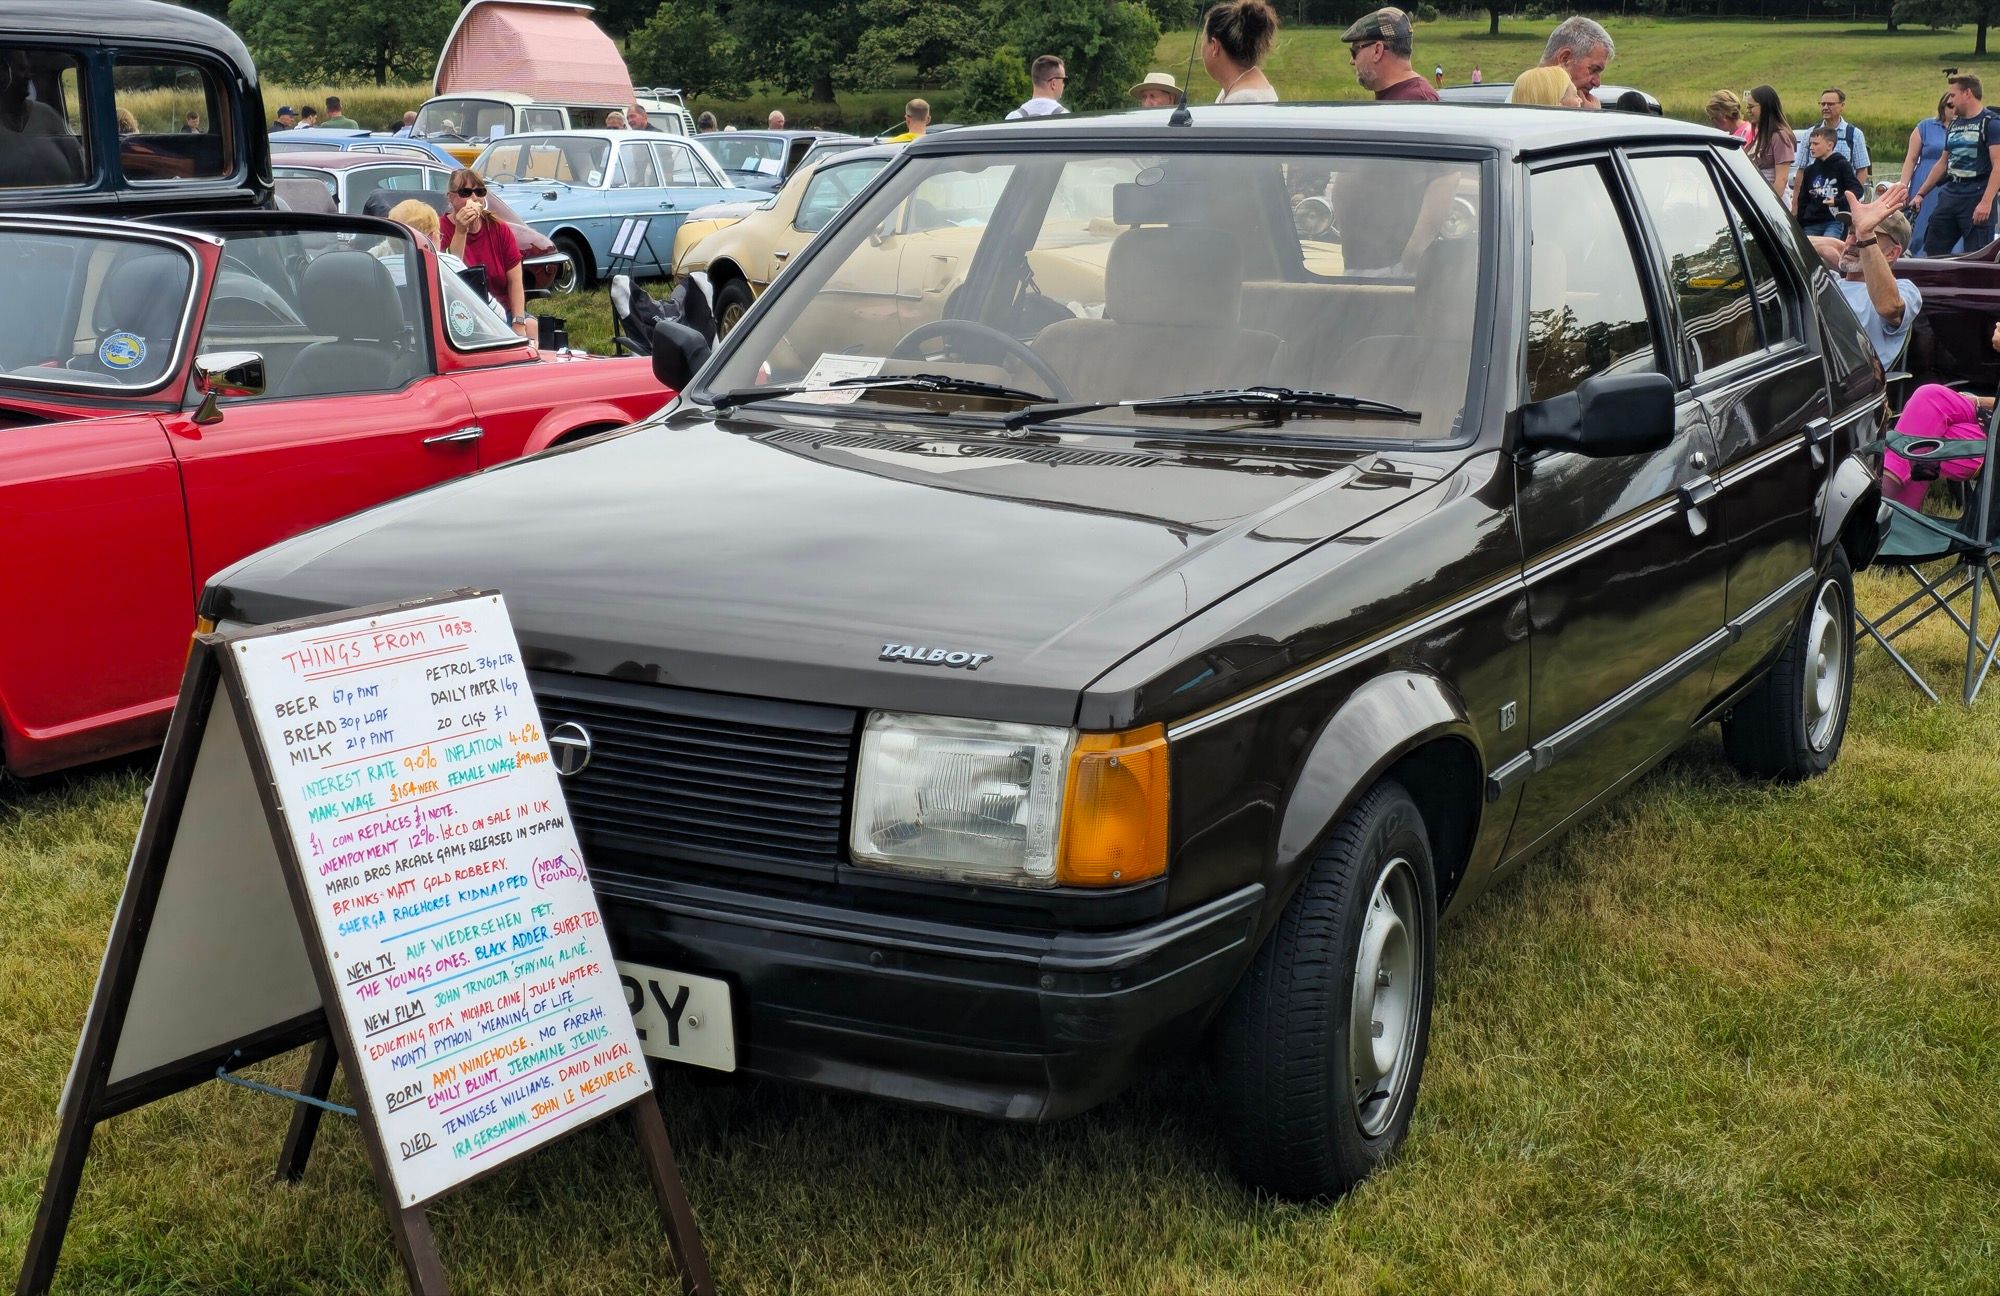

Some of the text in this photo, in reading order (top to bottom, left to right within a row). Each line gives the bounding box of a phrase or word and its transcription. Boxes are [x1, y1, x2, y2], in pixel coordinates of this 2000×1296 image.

[282, 621, 477, 673] THINGS FROM 1983.
[426, 661, 476, 681] PETROL
[499, 653, 515, 665] LTR
[879, 643, 993, 671] TALBOT
[275, 696, 319, 718] BEER
[357, 685, 379, 698] PINT
[431, 685, 466, 705] DAILY
[470, 679, 499, 697] PAPER
[283, 720, 337, 746] BREAD
[364, 708, 388, 725] LOAF
[437, 705, 508, 731] 20 CIGS £1
[289, 741, 332, 766] MILK
[370, 730, 394, 745] PINT
[302, 768, 361, 801] INTEREST
[367, 760, 399, 783] RATE
[445, 734, 503, 763] INFLATION
[308, 803, 340, 824] MANS
[341, 792, 376, 814] WAGE
[447, 765, 486, 787] FEMALE
[487, 757, 517, 775] WAGE
[309, 832, 324, 856] £1
[332, 832, 354, 848] COIN
[357, 815, 412, 841] REPLACES
[455, 823, 468, 836] CD
[472, 819, 484, 831] ON
[487, 808, 512, 826] SALE
[517, 804, 528, 818] IN
[534, 800, 552, 813] UK
[325, 816, 564, 896] MARIO BROS ARCADE GAME RELEASED IN JAPAN
[338, 875, 528, 936] SHERGA RACEHORSE KIDNAPPED
[423, 872, 452, 893] GOLD
[346, 960, 372, 980] NEW
[406, 941, 426, 960] AUF
[431, 911, 522, 952] WIEDERSEHEN
[356, 980, 380, 1001] THE
[385, 964, 432, 991] YOUNGS
[474, 940, 508, 960] BLACK
[364, 1009, 390, 1032] NEW
[395, 999, 424, 1022] FILM
[434, 987, 460, 1008] JOHN
[461, 1000, 495, 1022] MICHAEL
[391, 1044, 427, 1071] MONTY
[433, 1029, 472, 1054] PYTHON
[533, 998, 547, 1014] OF
[385, 1080, 422, 1109] BORN
[432, 1065, 457, 1089] AMY
[539, 1026, 556, 1042] MO
[427, 1082, 461, 1110] EMILY
[507, 1042, 566, 1076] JERMAINE
[400, 1132, 432, 1158] DIED
[442, 1099, 498, 1136] TENNESSE
[558, 1060, 590, 1082] DAVID
[452, 1137, 472, 1159] IRA
[531, 1096, 559, 1120] JOHN
[563, 1088, 576, 1105] LE
